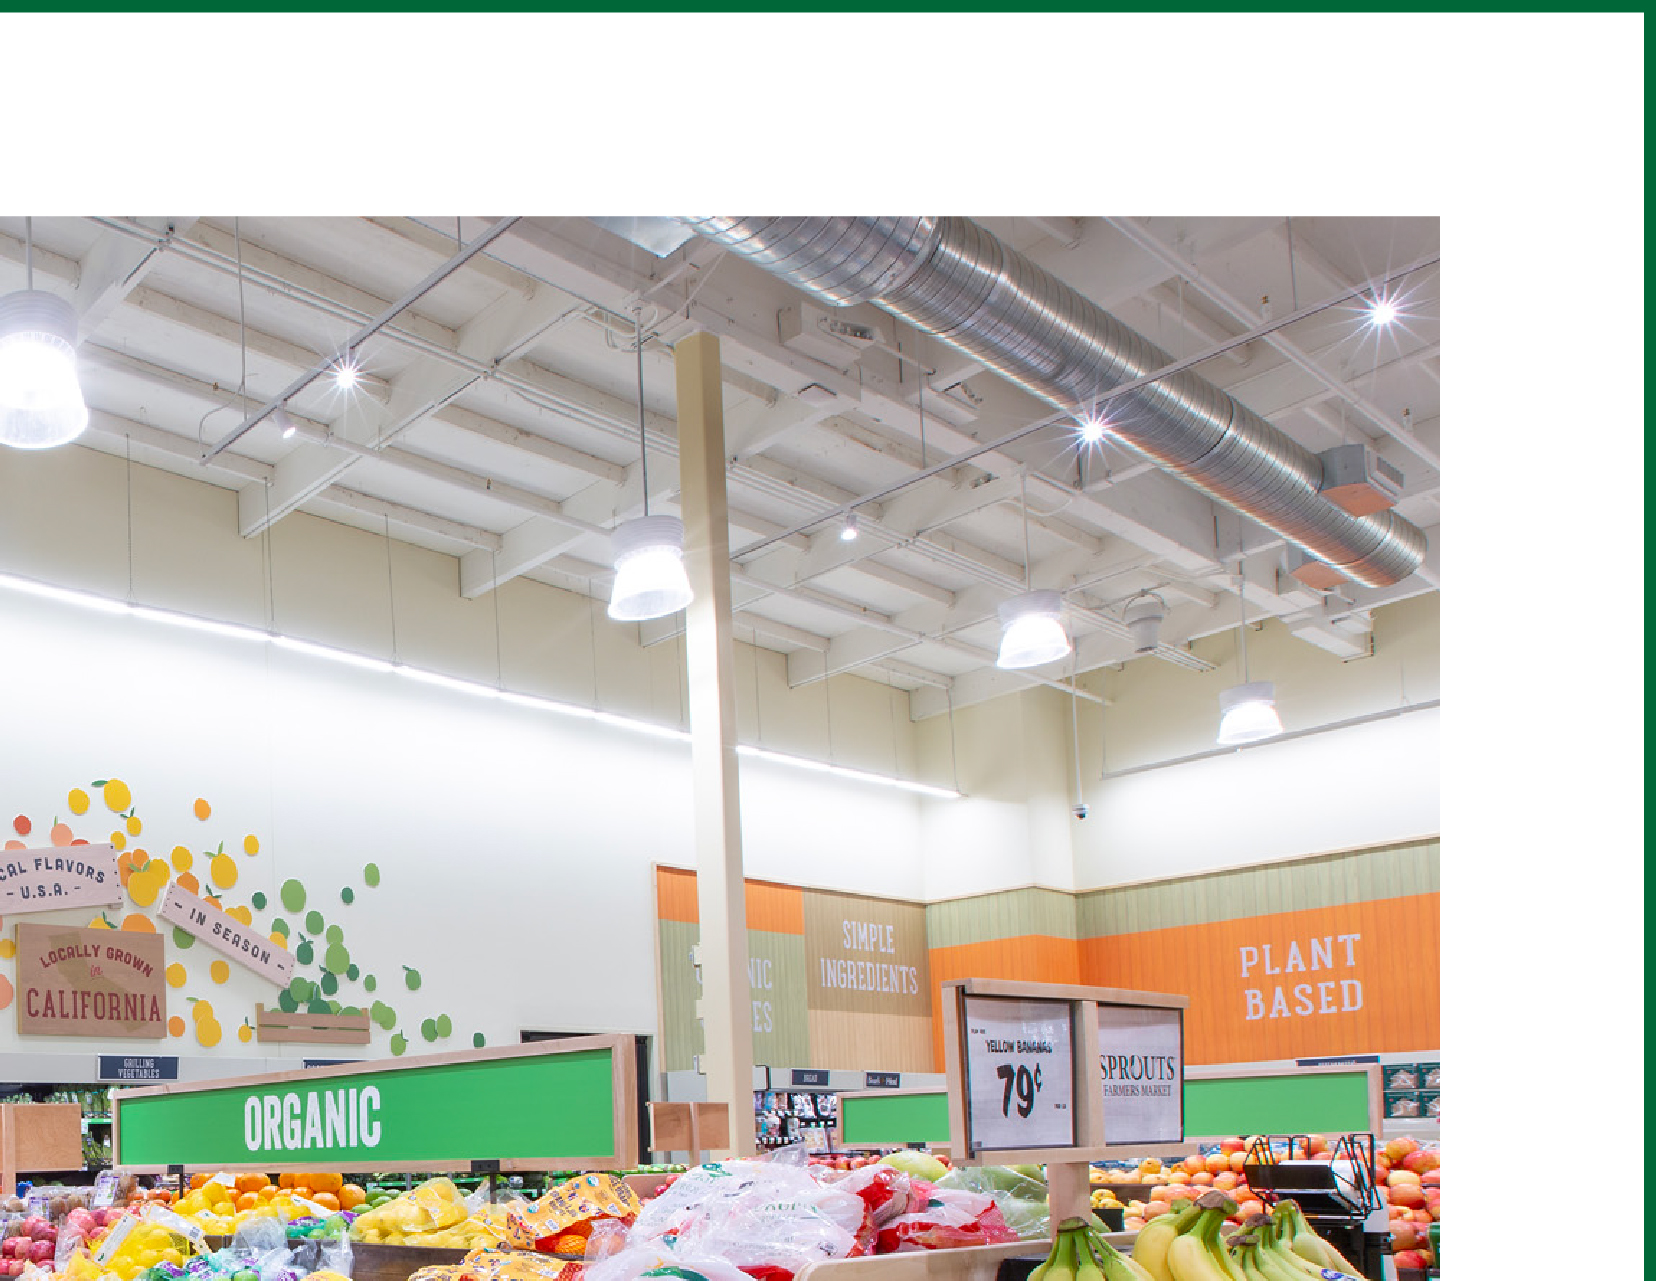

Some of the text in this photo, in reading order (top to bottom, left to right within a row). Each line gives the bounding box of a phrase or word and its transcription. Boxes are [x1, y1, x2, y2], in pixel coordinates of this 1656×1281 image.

[34, 858, 106, 884] FLAVORS
[188, 908, 271, 964] IN SEASON
[842, 919, 896, 953] SIMPLE
[40, 944, 153, 978] LOCALLY GROWN
[1239, 934, 1362, 978] PLANT
[821, 957, 918, 996] INGREDIENTS
[27, 988, 162, 1022] CALIFORNIA
[1244, 979, 1365, 1021] BASED
[1099, 1053, 1175, 1081] SPROUTS
[1102, 1084, 1171, 1097] FARMERS MARKET
[244, 1085, 382, 1153] ORGANIC
